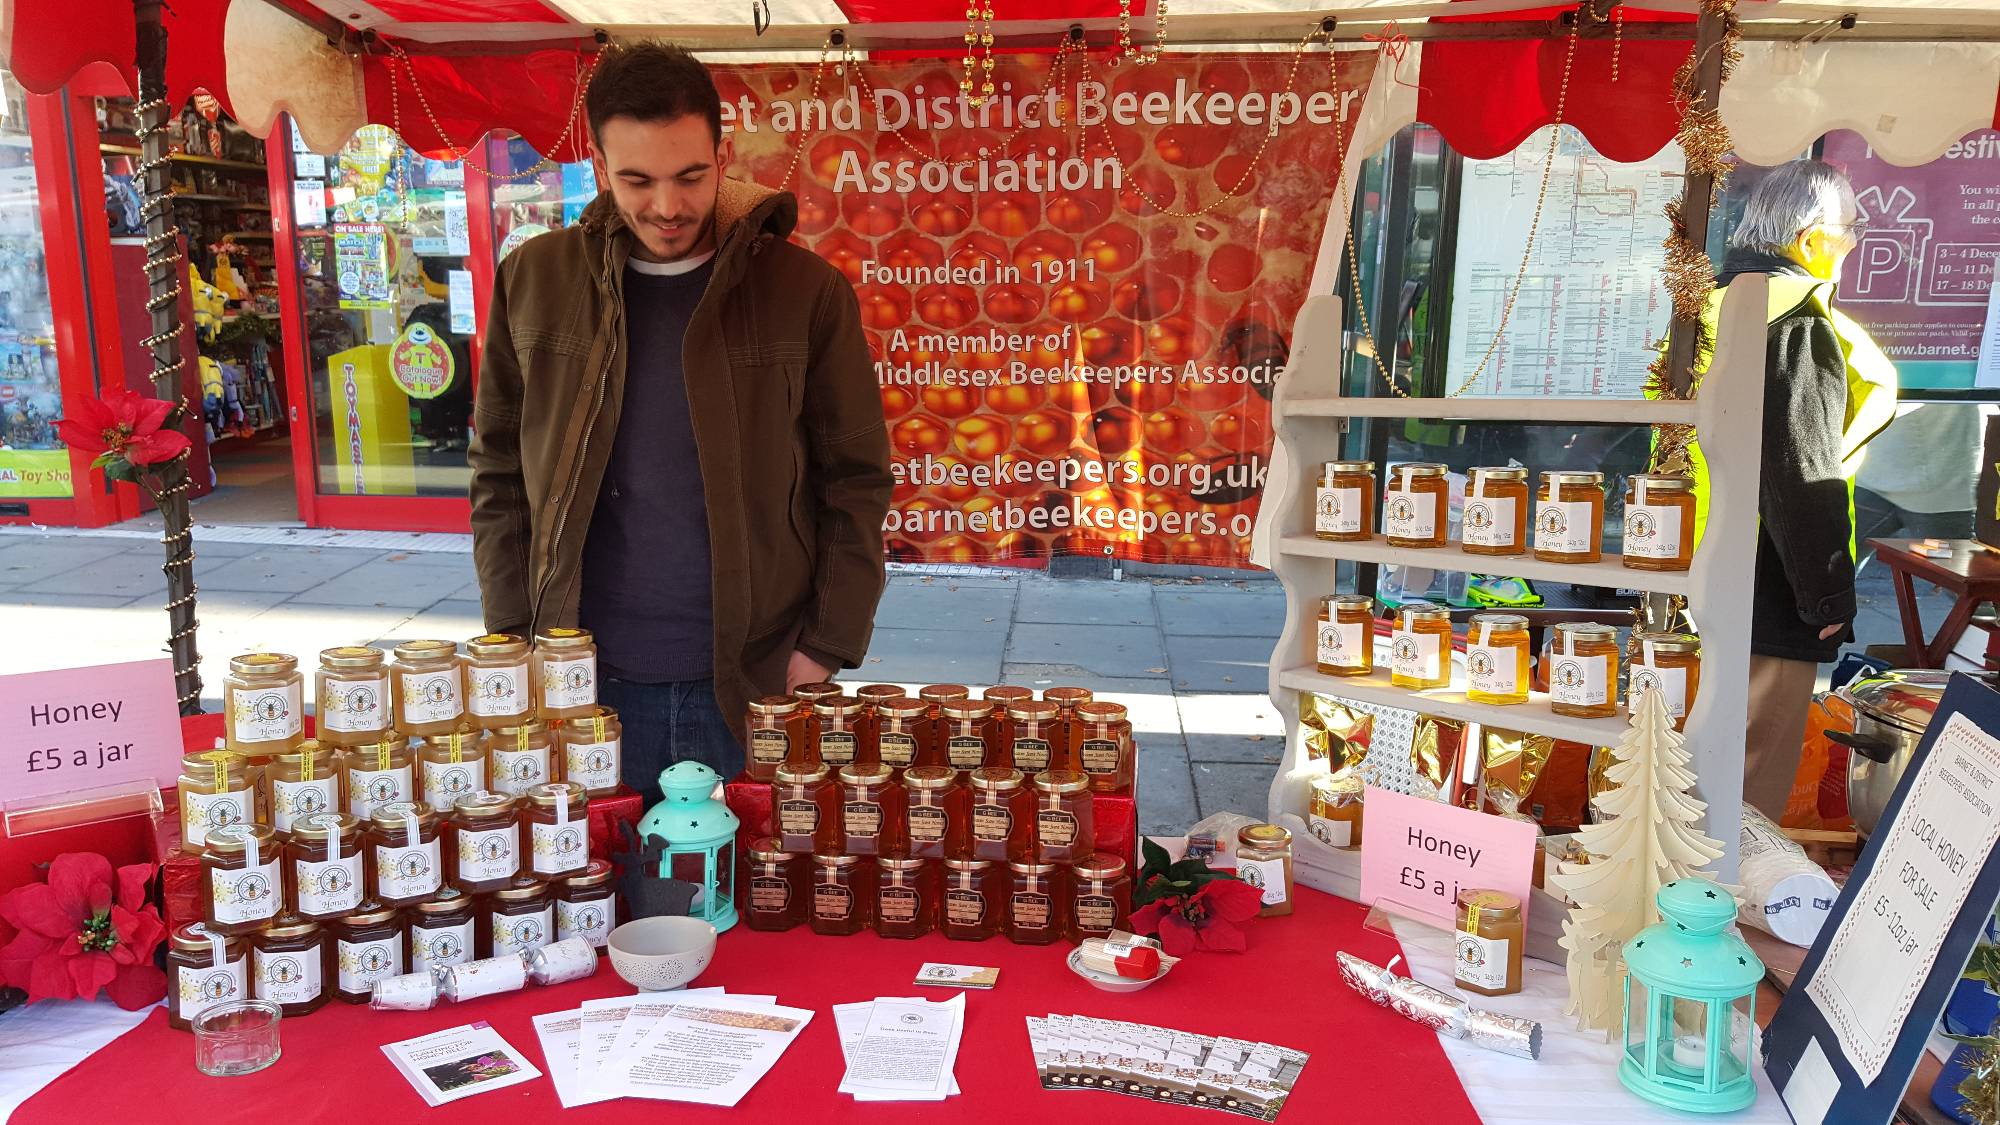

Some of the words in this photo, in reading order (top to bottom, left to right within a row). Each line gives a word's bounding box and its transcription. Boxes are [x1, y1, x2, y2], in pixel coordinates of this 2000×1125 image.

[770, 86, 862, 132] and
[874, 81, 1062, 132] District
[1076, 78, 1366, 137] Beekeeper
[832, 147, 1122, 193] Association
[1960, 185, 1981, 195] You
[1964, 200, 1974, 210] in
[1979, 200, 1993, 210] all
[1971, 214, 1990, 225] the
[1941, 249, 1948, 258] 3
[1960, 249, 1967, 258] 4
[862, 259, 986, 285] Founded
[996, 260, 1020, 284] in
[1031, 258, 1095, 284] 1911
[1939, 265, 1951, 274] 10
[1936, 281, 1949, 289] 17
[1961, 281, 1974, 289] 18
[890, 329, 909, 352] A
[918, 329, 1036, 353] member
[1043, 326, 1071, 351] of
[400, 365, 443, 376] Catalogue
[402, 374, 418, 383] Out
[1010, 359, 1173, 390] Beekeepers
[20, 470, 42, 485] Toy
[31, 701, 122, 726] Honey
[27, 748, 61, 773] £5
[73, 750, 87, 766] a
[97, 742, 133, 768] jar
[1953, 754, 1973, 775] BARNET
[1973, 771, 1994, 791] DISTRICT
[1961, 788, 1993, 817] ASSOCIATION
[1407, 826, 1481, 868] Honey
[1911, 813, 1935, 851] LOCAL
[1934, 838, 1968, 878] HONEY
[1399, 866, 1426, 890] £5
[1433, 880, 1445, 897] a
[1899, 861, 1918, 891] FOR
[1914, 877, 1938, 912] SALE
[1873, 895, 1890, 919] £5
[1887, 911, 1908, 944] 12oz
[1899, 931, 1920, 957] jar
[1457, 967, 1480, 982] Honey
[272, 988, 298, 1000] Honey
